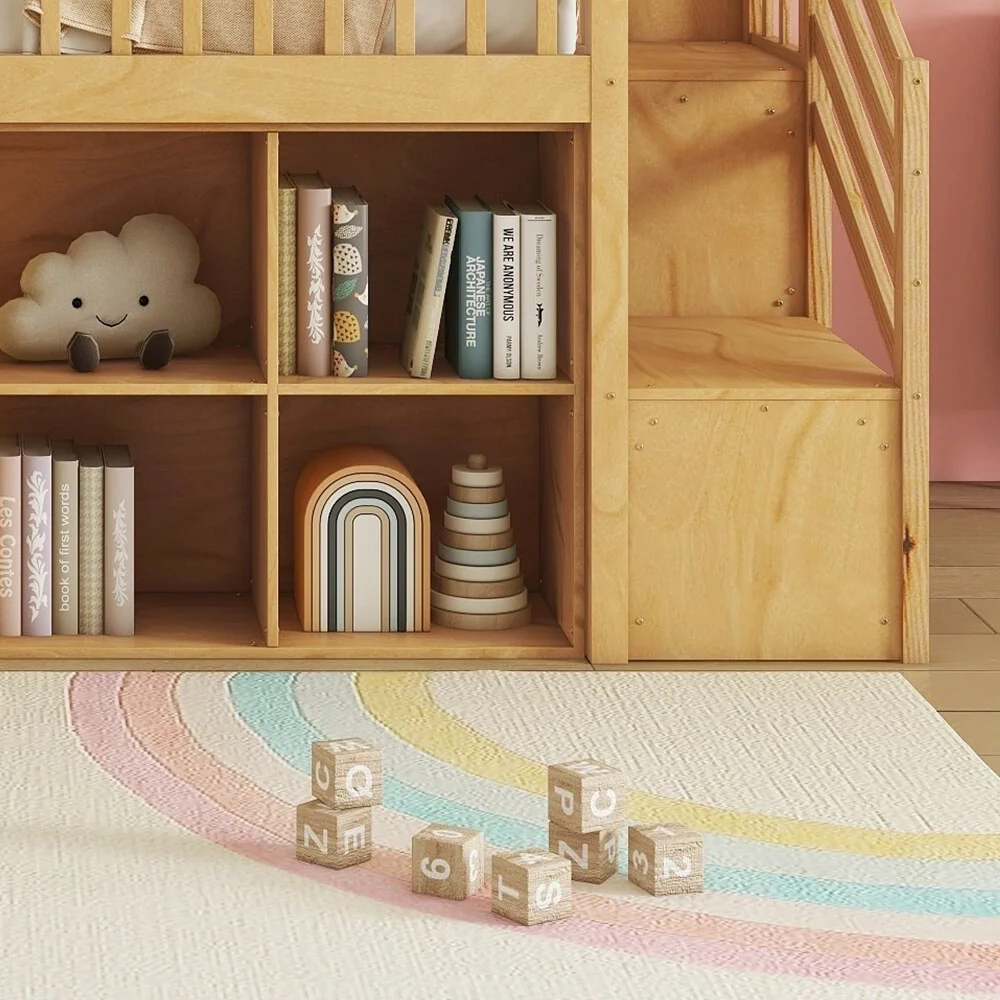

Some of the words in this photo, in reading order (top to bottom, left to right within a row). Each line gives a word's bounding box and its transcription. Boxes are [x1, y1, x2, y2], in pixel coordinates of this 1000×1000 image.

[503, 228, 514, 242] WE
[535, 233, 544, 264] Dreaming
[503, 244, 514, 262] ARE
[476, 256, 485, 317] JAPANESE
[503, 264, 514, 322] ANONYMOUS
[536, 273, 544, 297] Sweden
[466, 255, 476, 347] ARCHITECTURE
[0, 496, 16, 528] Les
[59, 483, 70, 527] words
[59, 530, 70, 557] first
[0, 533, 16, 598] Contes
[59, 558, 70, 574] of
[59, 578, 70, 612] book
[315, 761, 330, 791] C
[345, 764, 373, 798] Q
[554, 786, 574, 816] P
[590, 788, 617, 818] C
[497, 874, 520, 901] T
[535, 880, 562, 909] S
